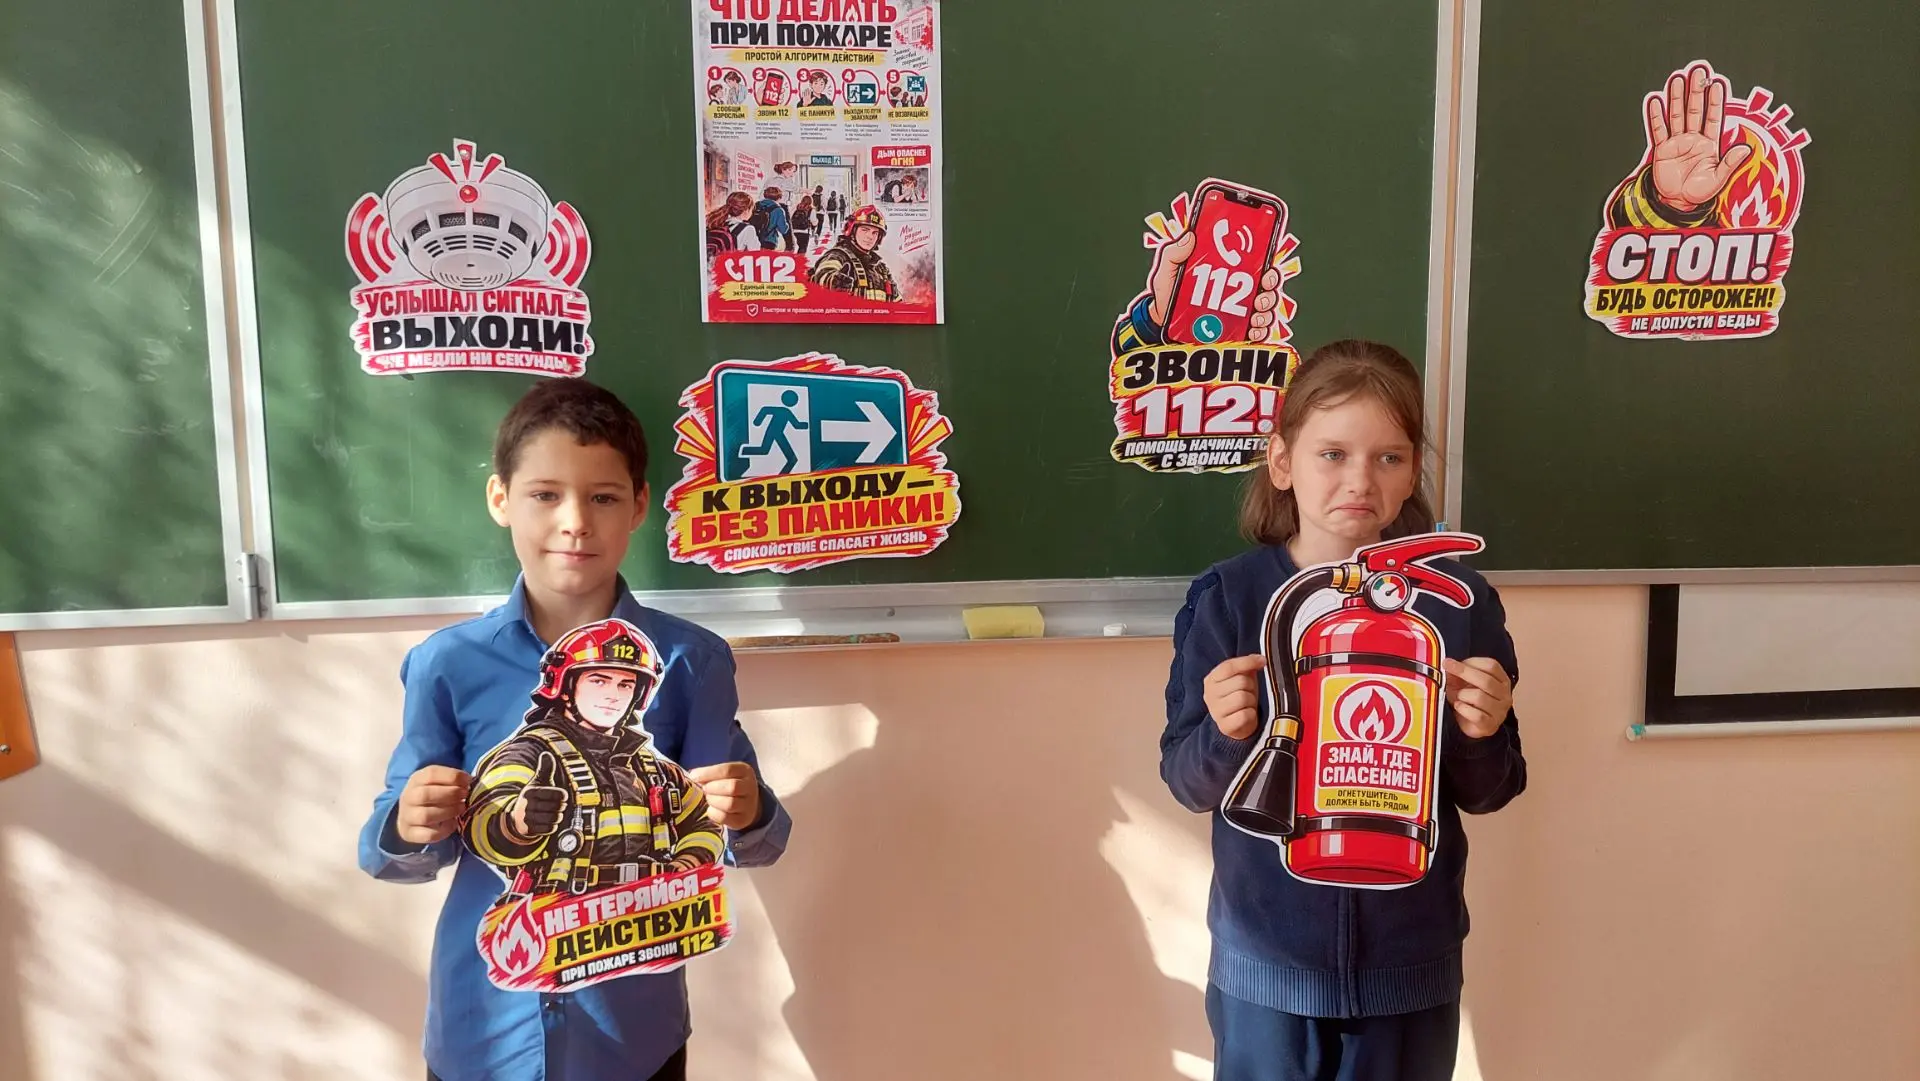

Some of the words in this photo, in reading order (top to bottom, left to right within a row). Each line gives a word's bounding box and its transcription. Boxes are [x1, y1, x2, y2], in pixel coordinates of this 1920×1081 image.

[710, 0, 770, 21] ЧТО
[777, 0, 897, 23] ДЕЛАТЬ
[710, 22, 769, 45] ПРИ
[777, 23, 892, 48] ПОЖАРЕ
[745, 51, 783, 61] ПРОСТОЙ
[785, 52, 831, 62] АЛГОРИТМ
[832, 53, 875, 63] ДЕЙСТВИЙ
[756, 69, 762, 79] 2
[800, 70, 807, 80] 3
[844, 71, 852, 81] 4
[890, 71, 897, 81] 5
[808, 109, 835, 117] ПАНИКУЙ
[877, 150, 895, 159] ДЫМ
[897, 149, 927, 157] ОПАСНЕЕ
[891, 157, 915, 166] ОГНЯ
[739, 256, 796, 283] 112
[1606, 232, 1775, 283] СТОП!
[1190, 263, 1254, 317] 112
[1596, 288, 1647, 313] БУДЬ
[1652, 287, 1776, 310] ОСТОРОЖЕН!
[365, 289, 477, 318] УСЛЫШАЛ
[1631, 317, 1649, 331] НЕ
[1651, 315, 1713, 331] ДОПУСТИ
[1718, 314, 1761, 329] БЕДЫ
[372, 316, 586, 354] ВЫХОДИ!
[409, 352, 467, 368] МЕДЛИ
[470, 353, 492, 368] НИ
[1123, 349, 1289, 390] ЗВОНИ
[1133, 385, 1278, 436] 112!
[1124, 440, 1187, 456] ПОМОЩЬ
[1189, 438, 1268, 451] НАЧИНАЕТС
[1161, 453, 1177, 468] С
[1179, 452, 1242, 468] ЗВОНКА
[702, 488, 733, 513] К
[691, 510, 769, 546] БЕЗ
[778, 492, 944, 537] ПАНИКИ!
[723, 540, 816, 562] СПОКОЙСТВИЕ
[819, 534, 878, 552] СПАСАЕТ
[880, 531, 927, 546] ЖИЗНЬ
[612, 643, 635, 660] 112
[1327, 744, 1378, 766] ЗНАЙ,
[1382, 749, 1413, 769] ГДЕ
[1322, 766, 1417, 790] СПАСЕНИЕ!
[1325, 798, 1358, 807] ДОЛЖЕН
[1359, 800, 1381, 809] БЫТЬ
[1383, 801, 1410, 812] РЯДОМ
[1337, 789, 1399, 801] ОГНЕТУШИТЕЛЬ
[543, 908, 582, 936] НЕ
[554, 893, 723, 966] ДЕЙСТВУЙ!
[561, 966, 586, 983] ПРИ
[588, 953, 636, 976] ПОЖАРЕ
[639, 941, 678, 963] ЗВОНИ
[679, 931, 715, 957] 112
